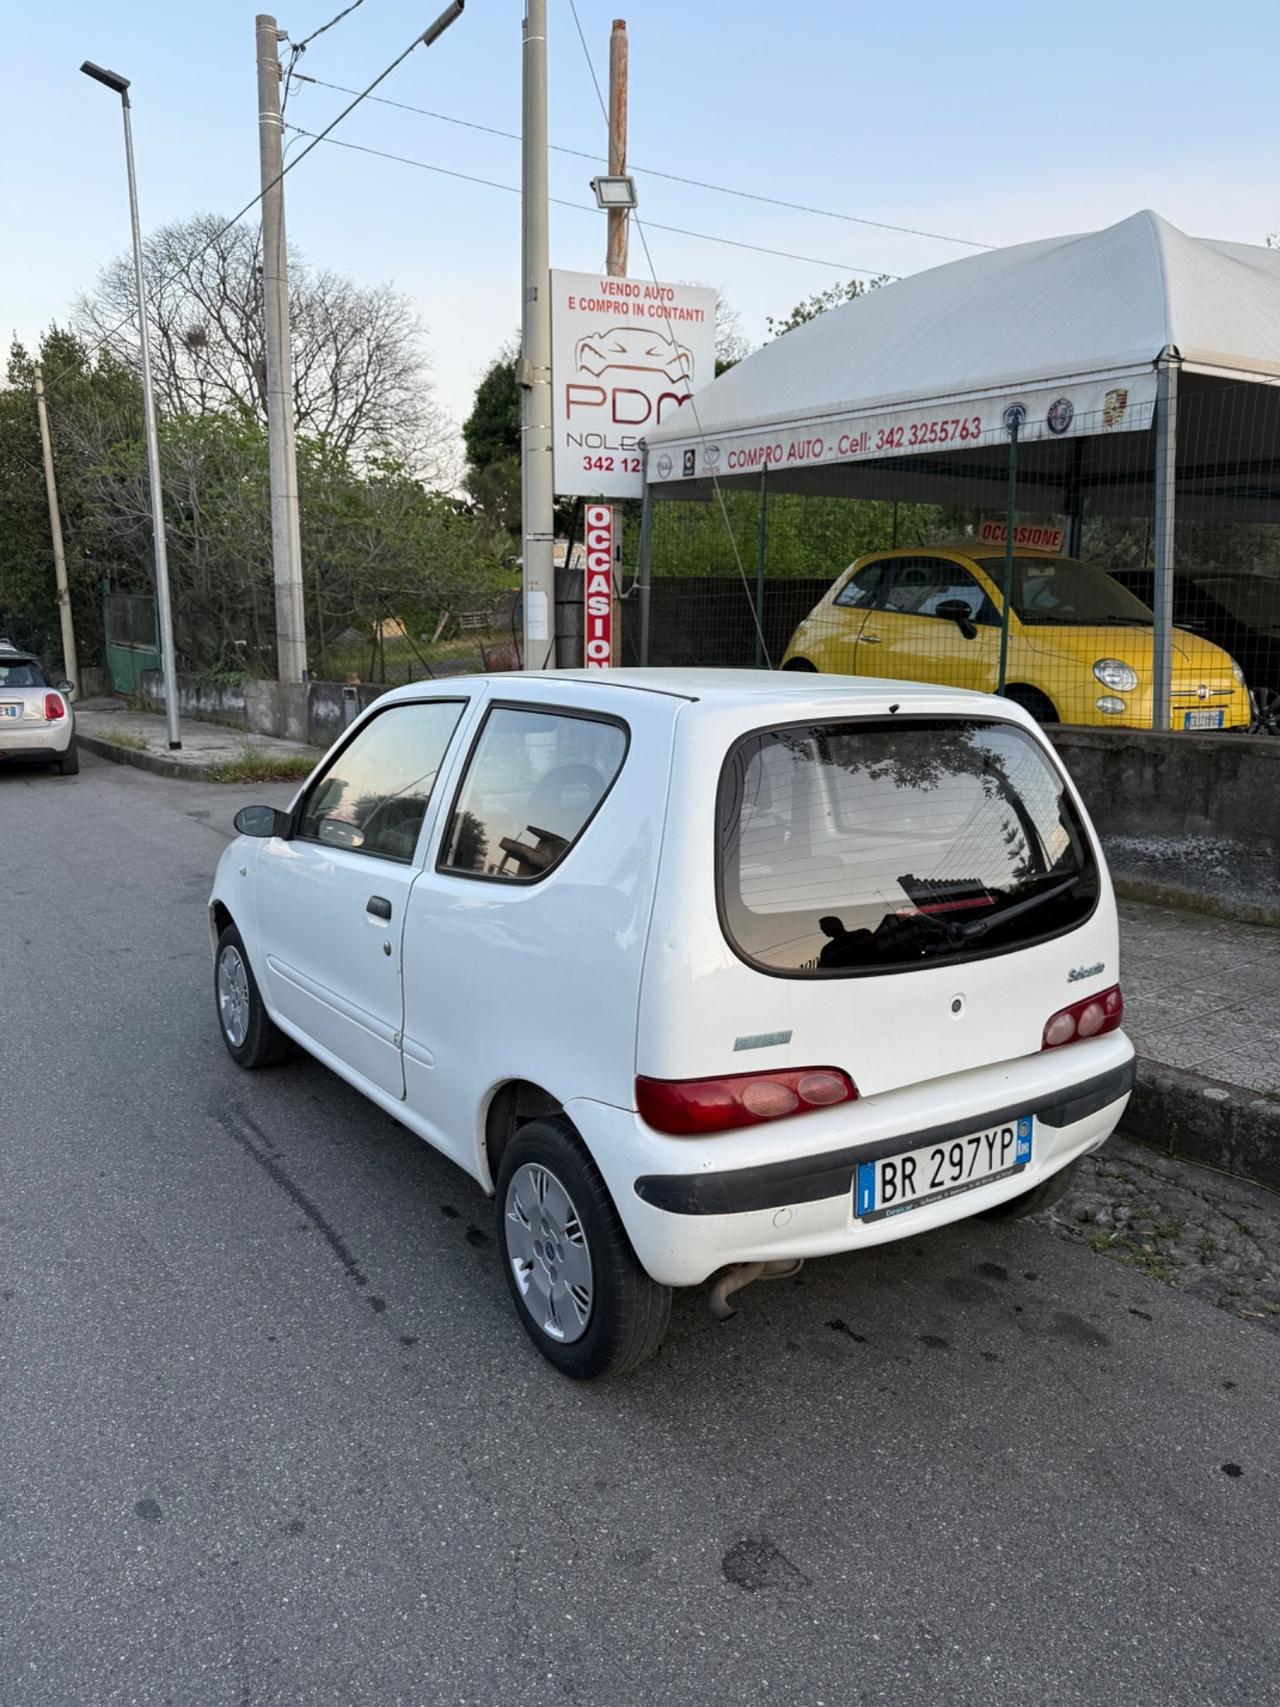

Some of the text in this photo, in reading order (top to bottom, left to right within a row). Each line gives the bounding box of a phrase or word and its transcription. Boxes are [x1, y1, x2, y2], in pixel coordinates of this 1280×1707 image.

[600, 281, 674, 301] VENDO AUTO
[568, 296, 705, 322] E COMPRO IN CONTANTI
[566, 432, 644, 452] NOLE
[727, 444, 783, 469] COMPRO
[787, 438, 824, 461] AUTO
[838, 431, 872, 455] Cell:
[876, 426, 905, 450] 342
[908, 416, 982, 446] 3255763
[583, 456, 615, 472] 342
[620, 457, 644, 473] 12
[880, 1156, 917, 1204] BR
[929, 1127, 1014, 1189] 297YP
